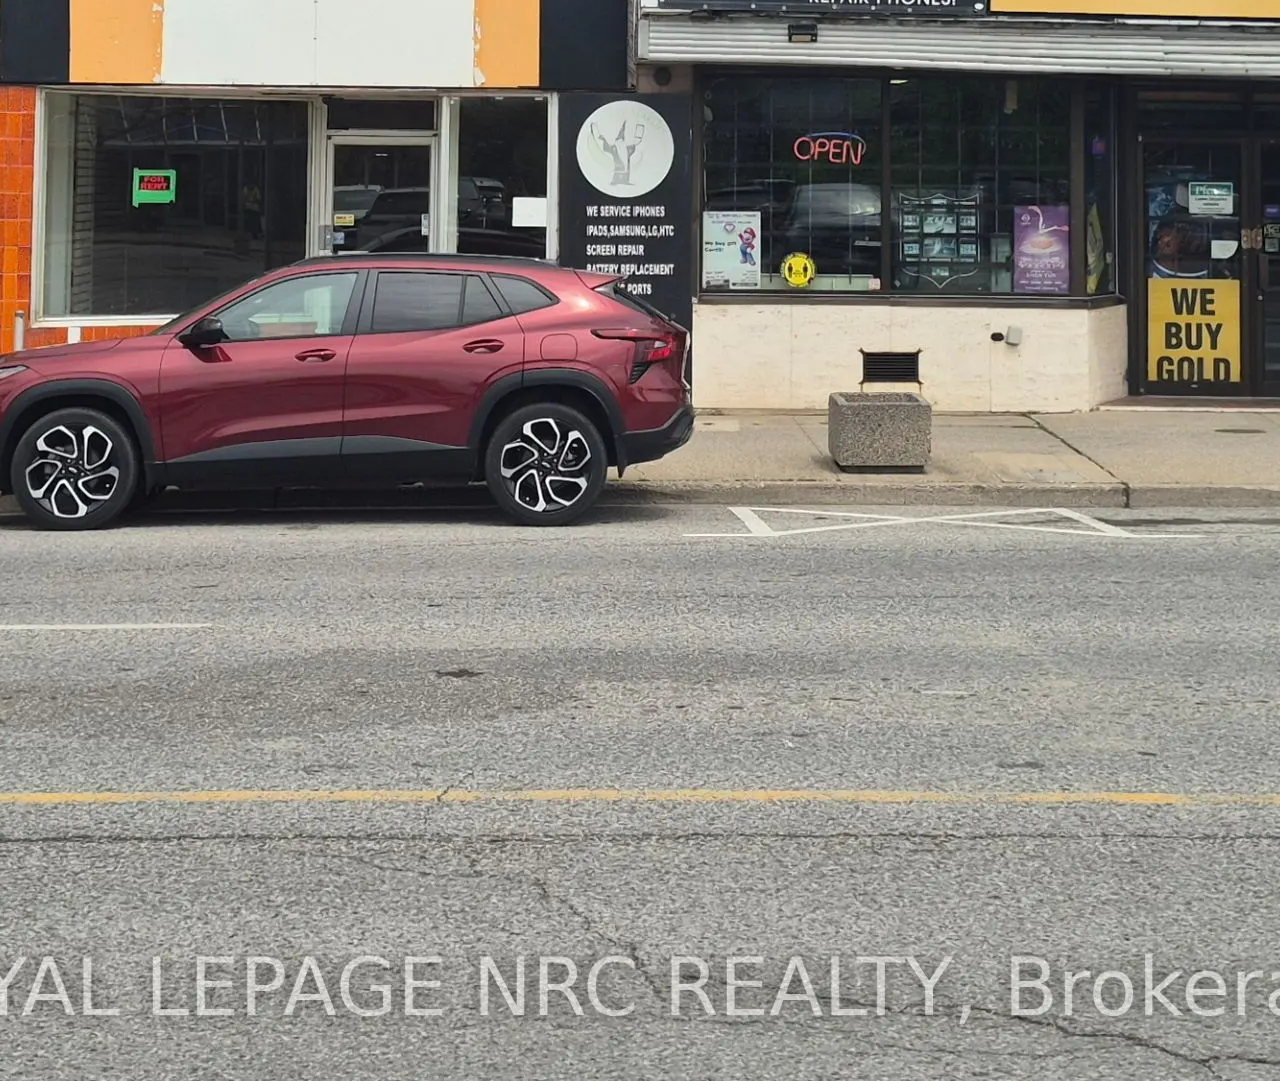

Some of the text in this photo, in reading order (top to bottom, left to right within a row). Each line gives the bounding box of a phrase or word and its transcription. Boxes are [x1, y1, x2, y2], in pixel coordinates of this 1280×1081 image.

[794, 137, 862, 164] OPEN
[140, 182, 168, 190] RENT
[586, 206, 665, 218] WE SERVICE IPHONES
[586, 244, 645, 256] SCREEN REPAIR
[619, 263, 675, 275] REPLACEMENT
[627, 283, 652, 295] PORTS
[1171, 288, 1216, 316] WE
[1164, 322, 1223, 350] BUY
[1157, 356, 1231, 381] GOLD
